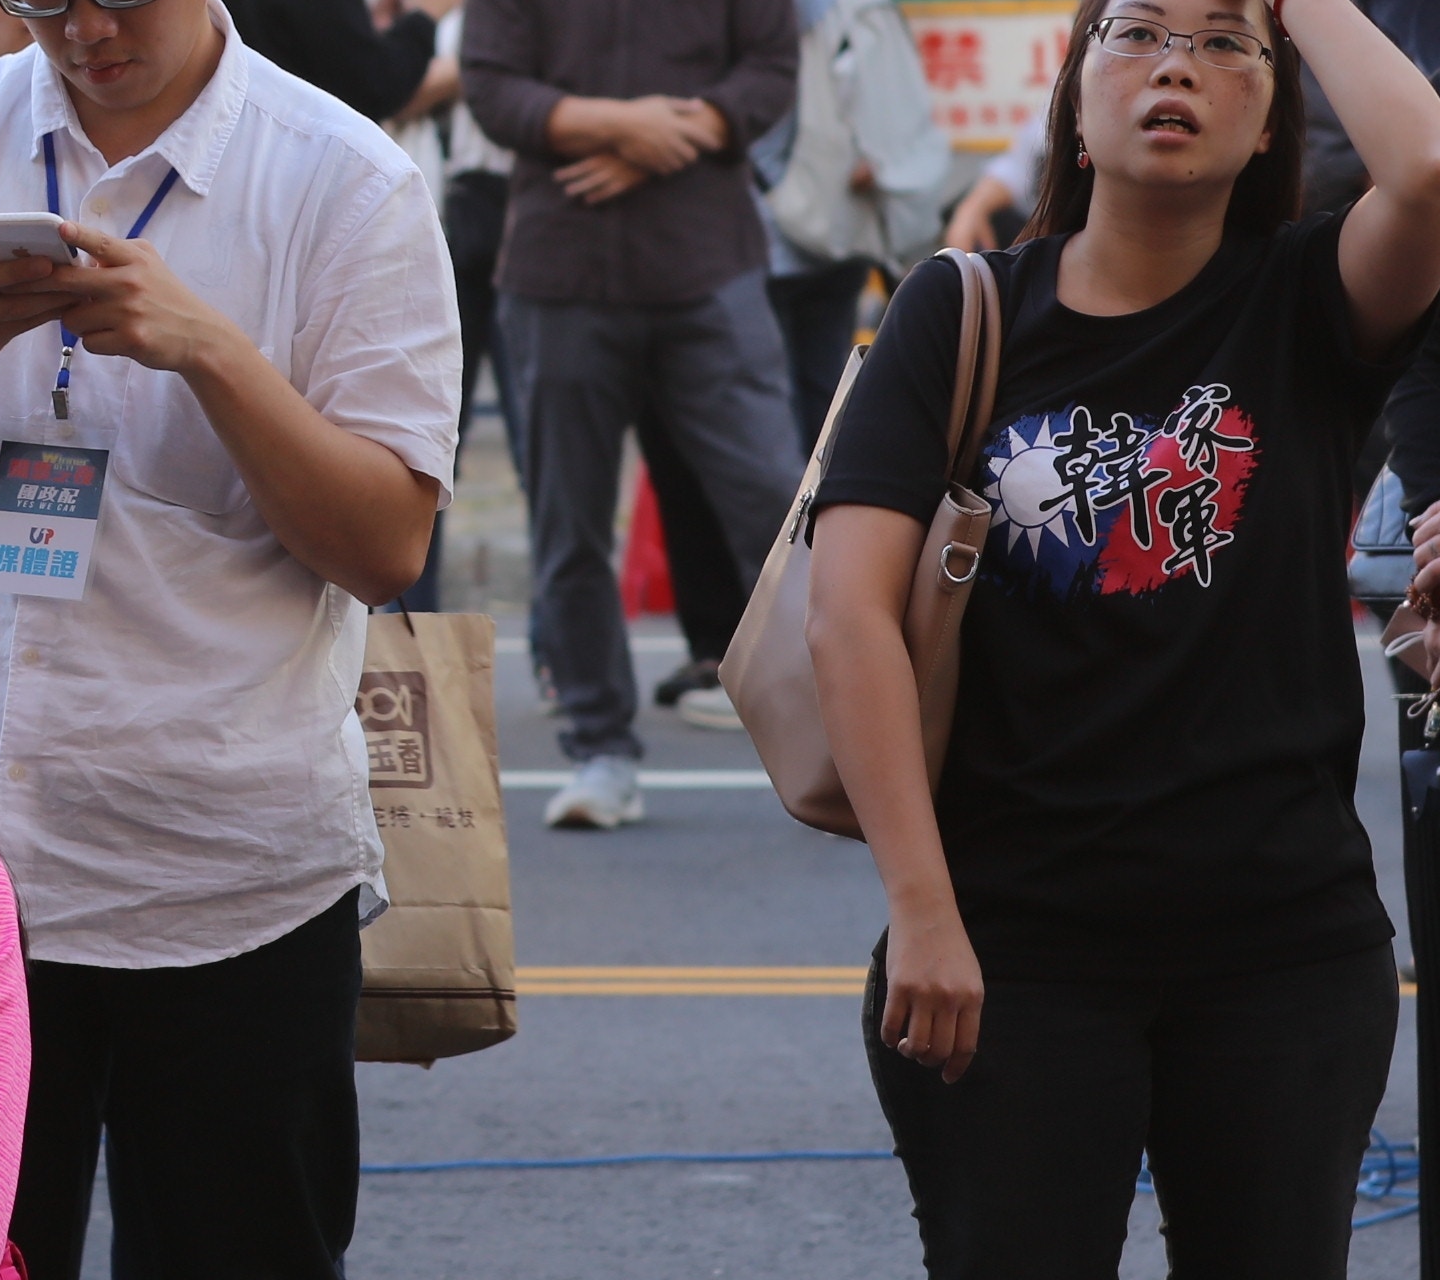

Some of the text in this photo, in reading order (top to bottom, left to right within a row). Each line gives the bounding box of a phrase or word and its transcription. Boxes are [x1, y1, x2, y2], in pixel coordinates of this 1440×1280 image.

[16, 483, 81, 505] 國政配
[16, 500, 77, 512] YES WE CAN
